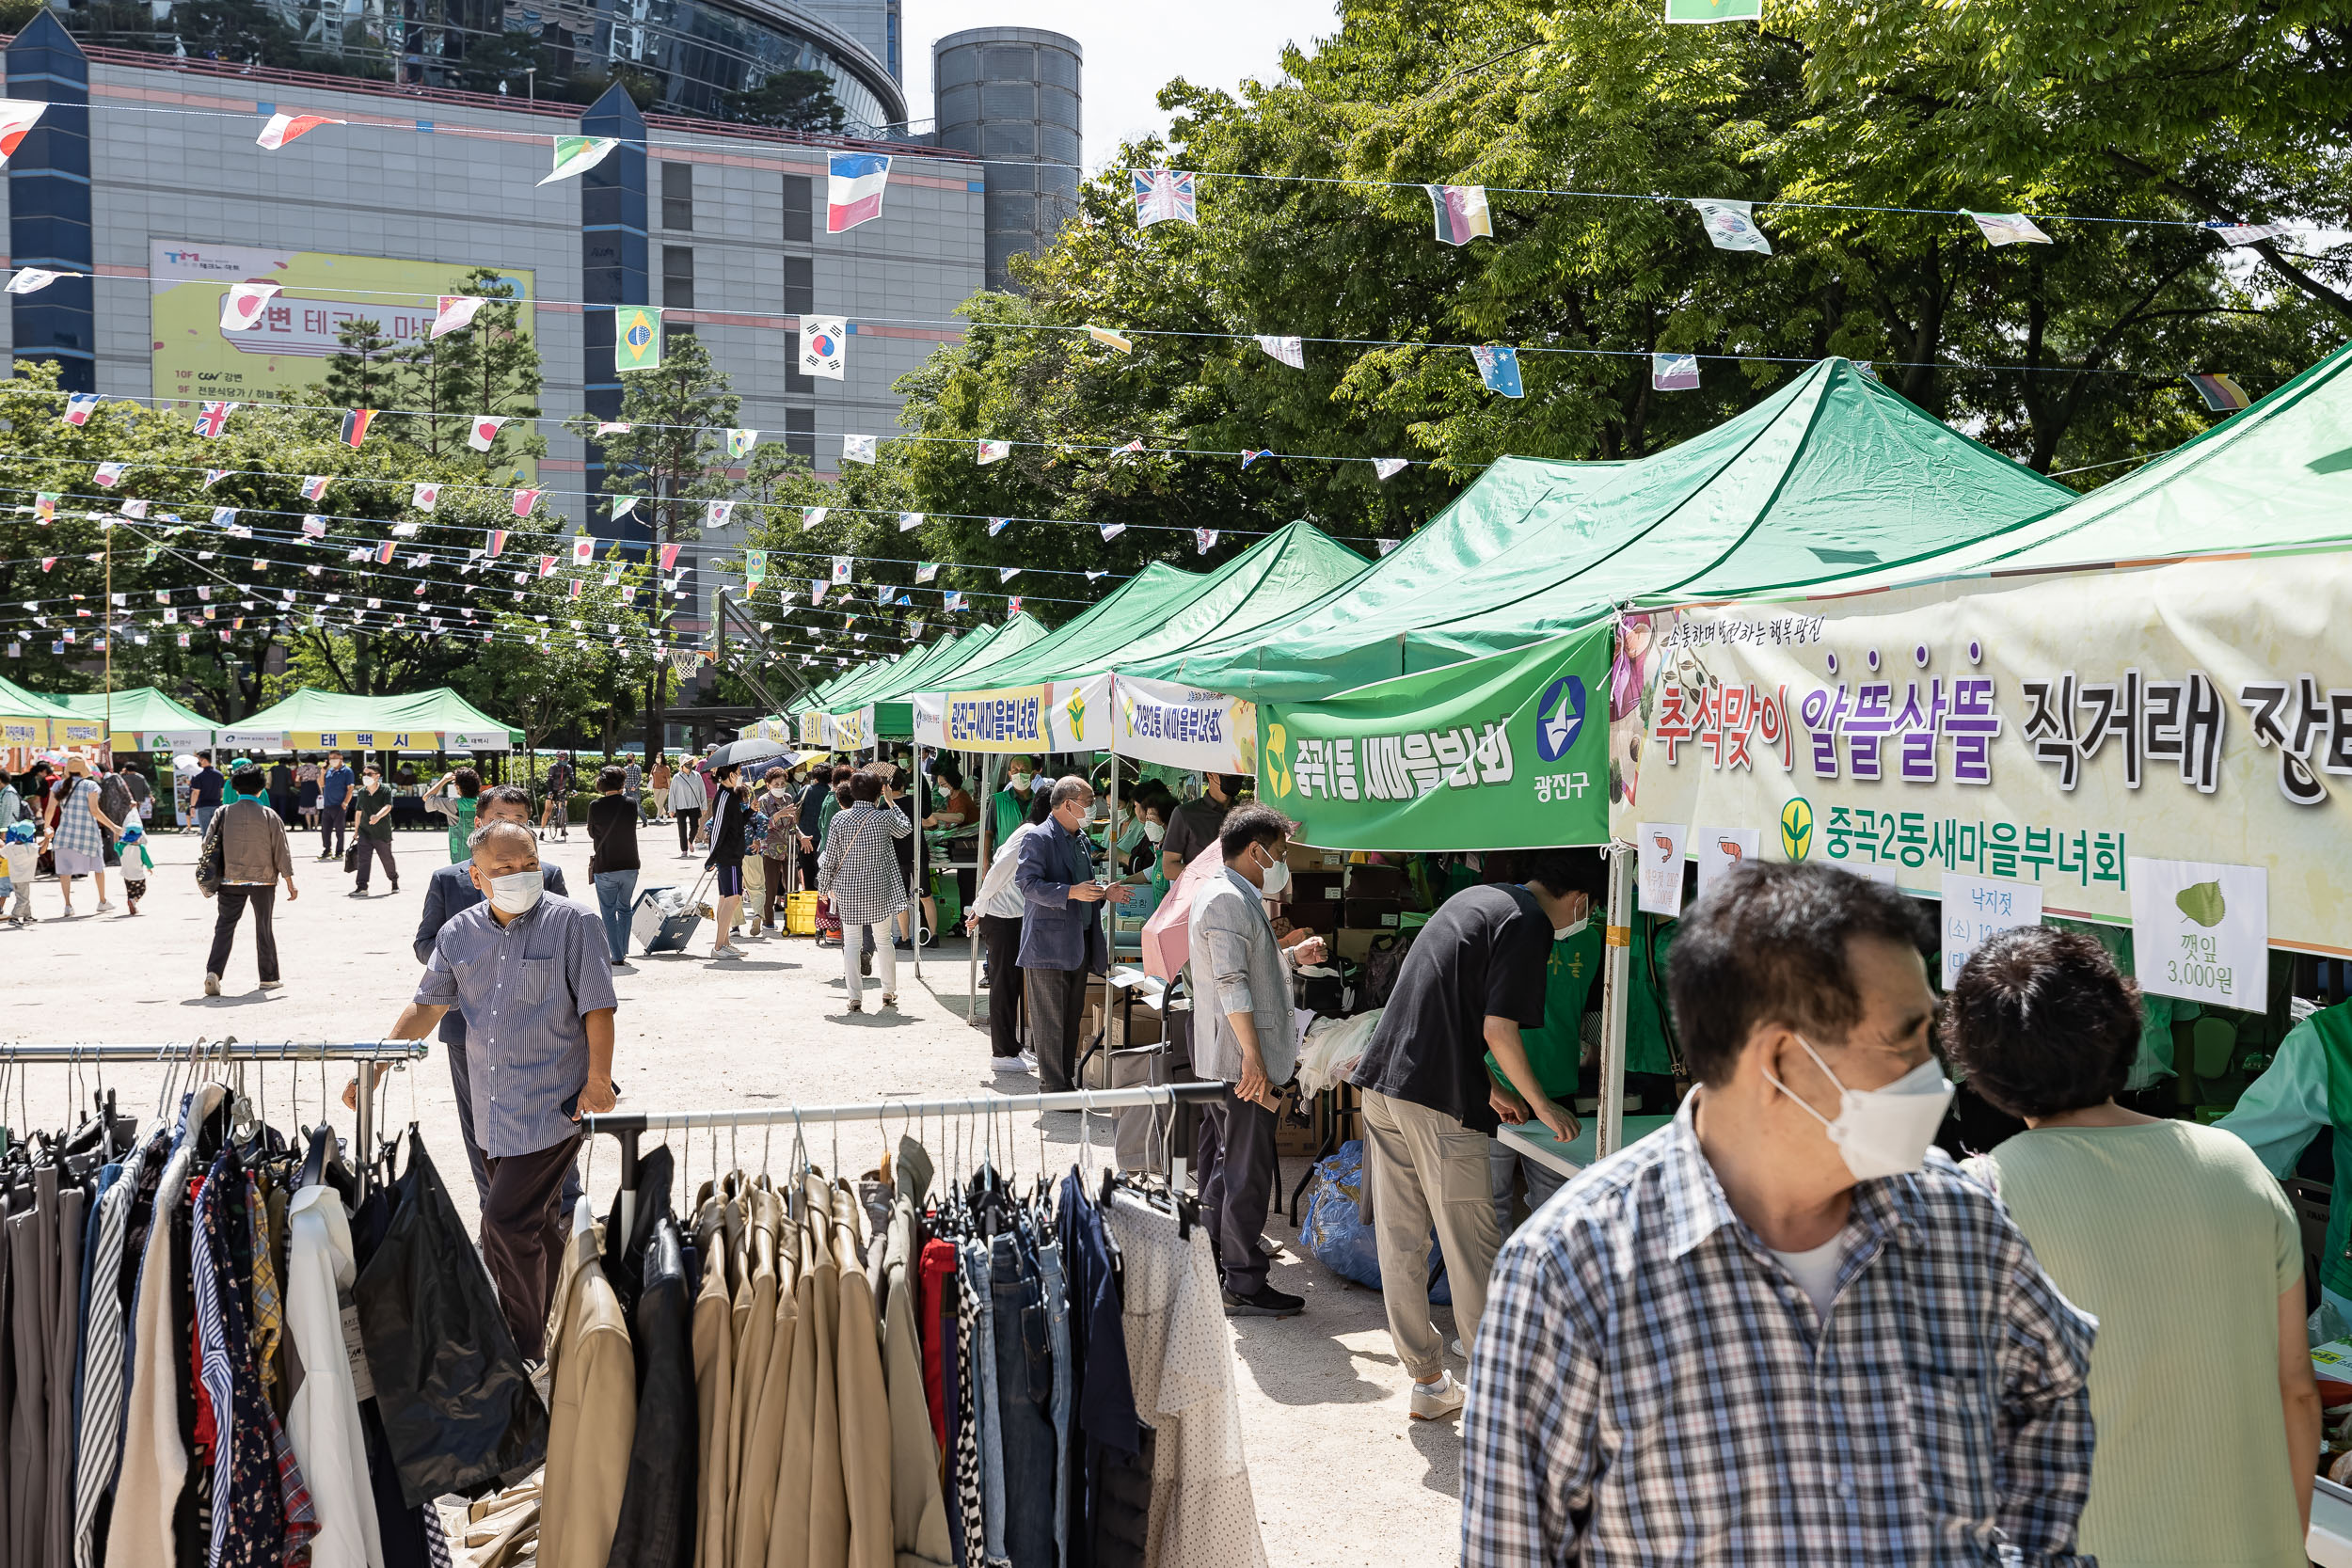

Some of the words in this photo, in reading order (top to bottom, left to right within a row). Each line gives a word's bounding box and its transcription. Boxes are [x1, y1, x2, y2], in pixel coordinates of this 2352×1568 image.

[248, 306, 292, 332] 변
[174, 371, 193, 379] 10F
[198, 372, 222, 381] CGV
[225, 372, 243, 383] 강변
[178, 386, 190, 394] 9F
[199, 386, 245, 398] 전문식당가
[1670, 622, 1715, 648] 소통하며
[1719, 620, 1766, 646] 발전하는
[1164, 707, 1223, 743] 새마을부녀회
[1656, 684, 1791, 768] 추석맞이
[1801, 677, 1999, 781] 알뜰살뜰
[2023, 672, 2226, 788] 직거래
[1534, 771, 1591, 803] 광진구
[1972, 888, 2011, 916] 낙지젓
[1947, 916, 1970, 942] (소)
[2181, 934, 2217, 963] 깻잎
[2168, 960, 2233, 995] 3,000원
